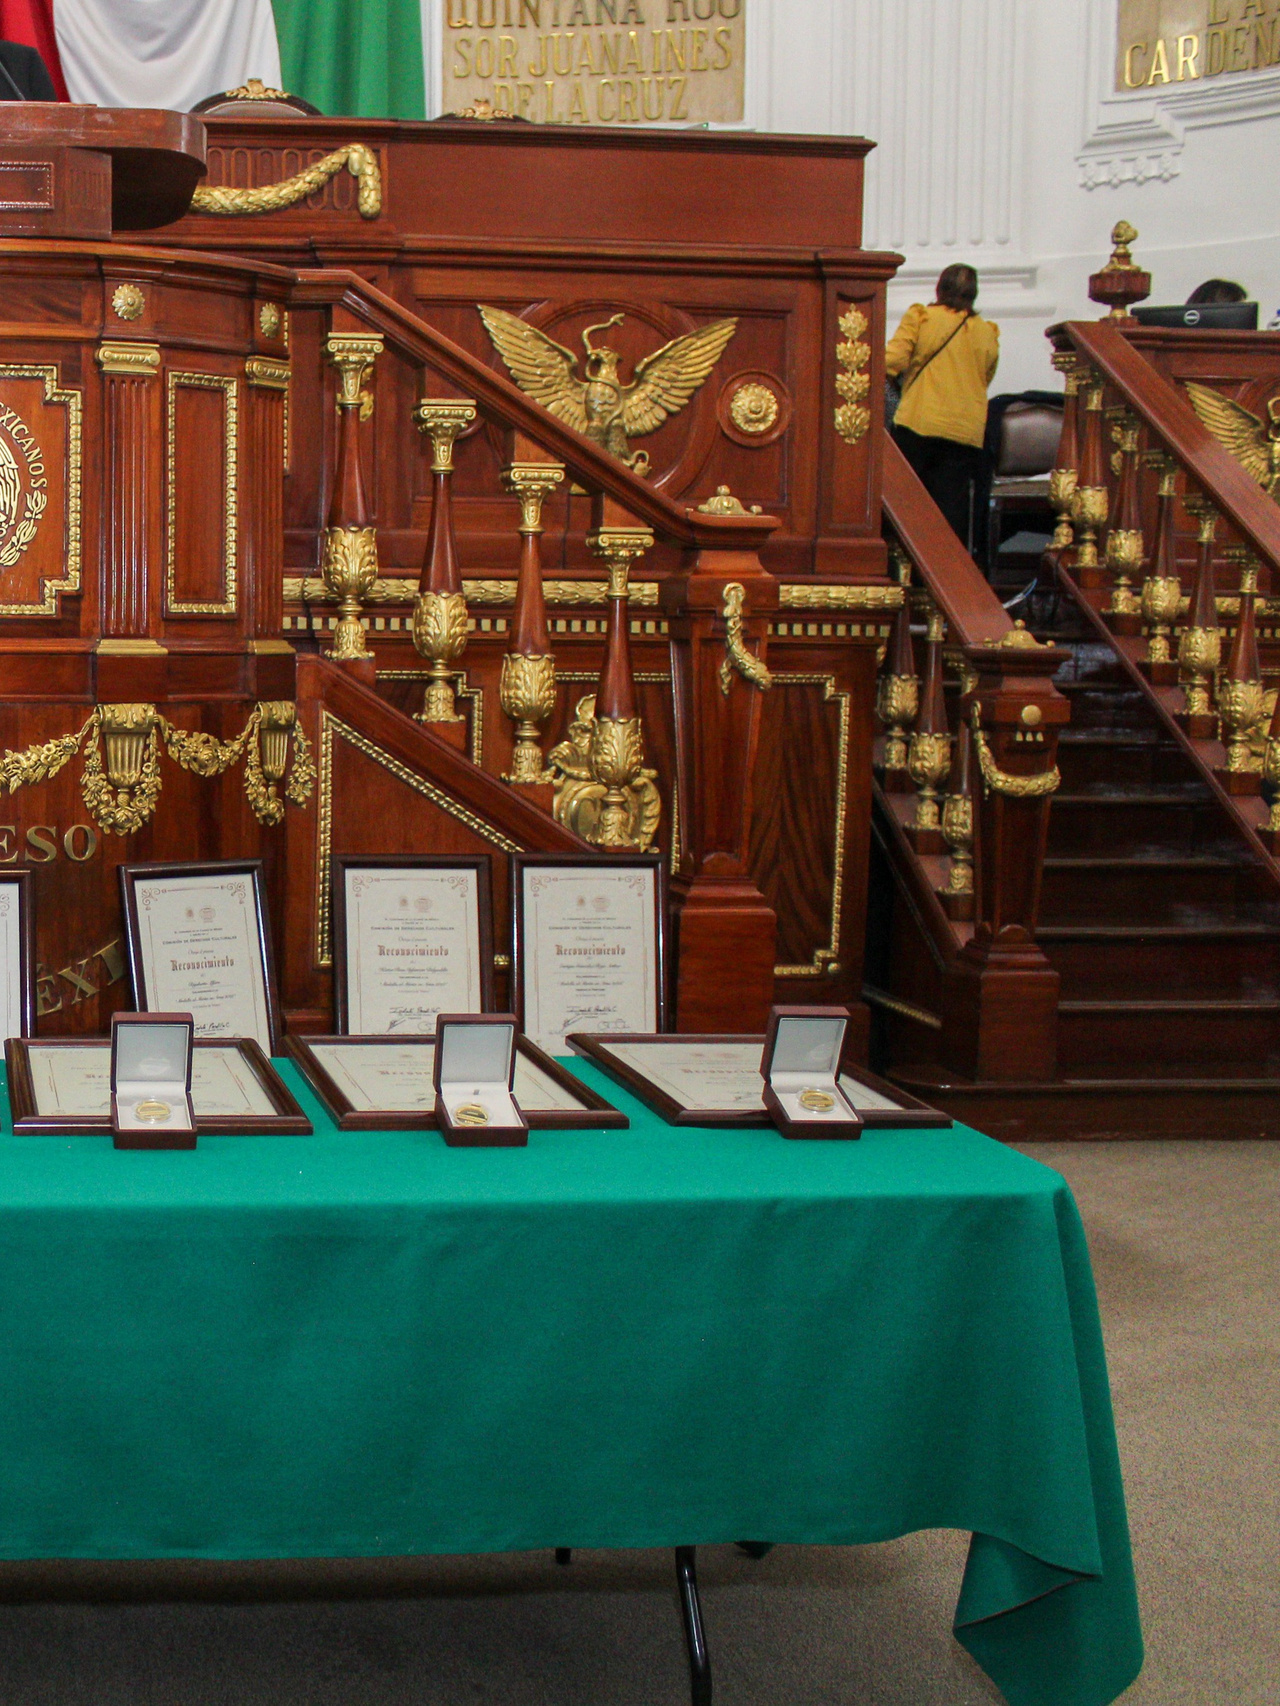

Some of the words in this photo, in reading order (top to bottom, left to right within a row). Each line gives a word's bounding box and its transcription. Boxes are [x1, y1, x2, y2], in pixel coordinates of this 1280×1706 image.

[453, 35, 519, 78] SOR
[528, 31, 645, 77] JUANA
[651, 26, 733, 73] INES
[1124, 18, 1280, 88] CARDEN
[493, 82, 536, 124] DE
[544, 80, 590, 123] LA
[596, 76, 689, 122] CRUZ
[170, 955, 235, 972] Reconocimiento
